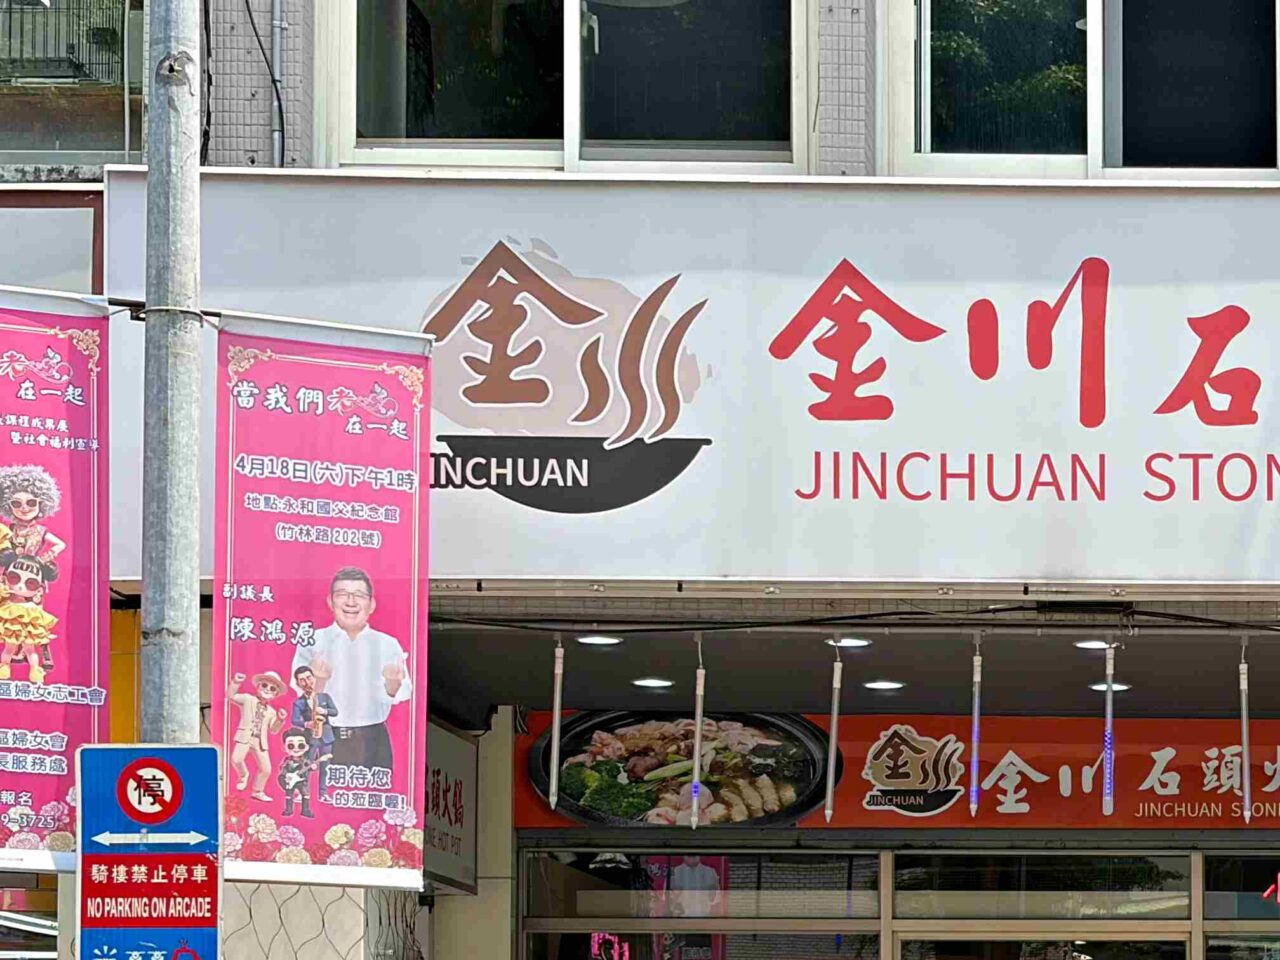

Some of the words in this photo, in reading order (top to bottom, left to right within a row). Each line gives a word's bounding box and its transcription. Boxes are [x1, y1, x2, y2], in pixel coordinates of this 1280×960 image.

[17, 379, 86, 406] 在一起
[0, 414, 69, 433] 課程成果展
[344, 415, 410, 441] 在一起
[235, 454, 417, 490] 4月18日(六)下午1時
[430, 456, 589, 488] INCHUAN
[794, 451, 1107, 502] JINCHUAN
[276, 523, 382, 548] (竹林路202號)
[222, 583, 275, 602] 副議長
[230, 617, 316, 646] 陳鴻源
[326, 766, 391, 789] 期待您
[868, 795, 924, 806] JINCHUAN
[1134, 801, 1223, 818] JINCHUAN
[90, 863, 209, 884] 騎樓禁止停車
[87, 897, 102, 918] NO
[104, 897, 150, 918] PARKING
[150, 897, 167, 918] ON
[169, 897, 211, 918] ARCADE
